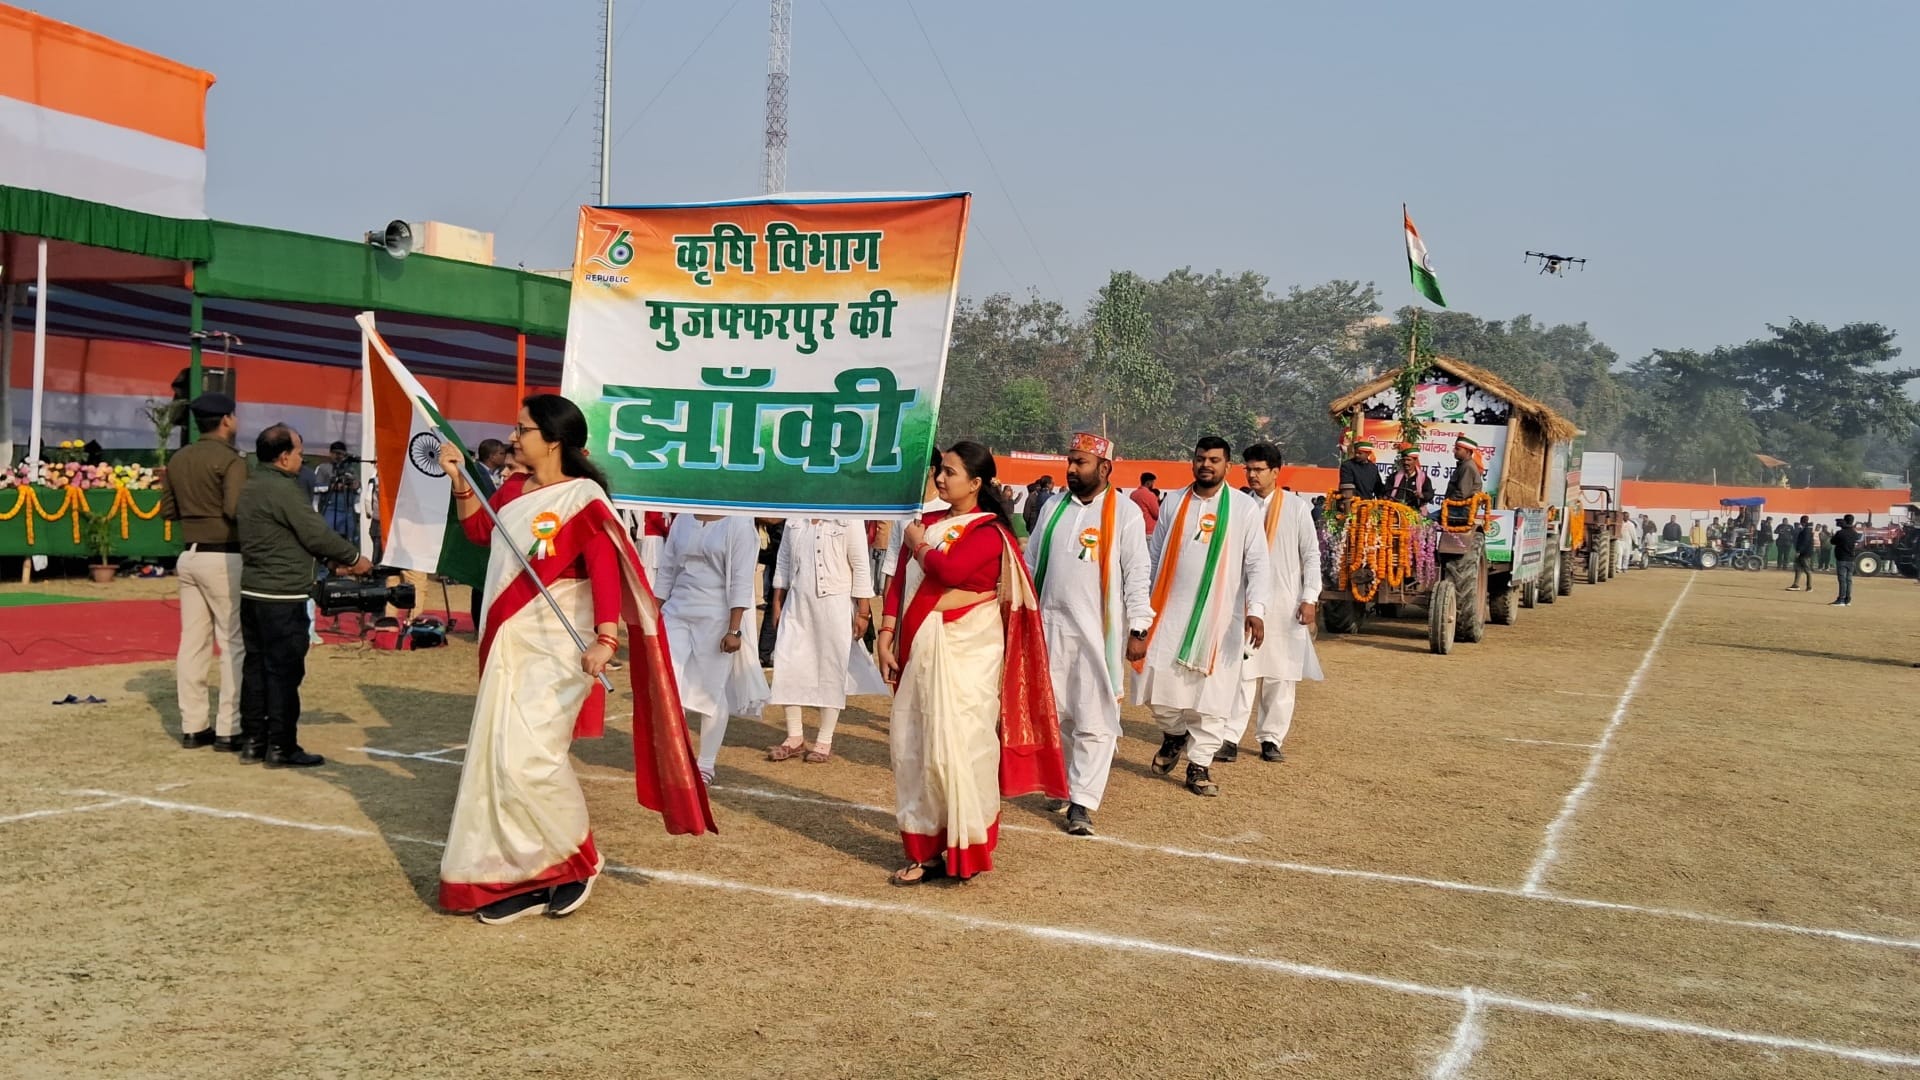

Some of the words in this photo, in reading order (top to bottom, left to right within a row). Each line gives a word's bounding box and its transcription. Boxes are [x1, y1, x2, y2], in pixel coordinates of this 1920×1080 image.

[594, 223, 634, 267] 76
[673, 223, 756, 286] कृषि
[765, 222, 882, 272] विभाग
[585, 274, 629, 283] REPUBLIC
[645, 300, 839, 355] मुजफ्फरपुर
[848, 290, 898, 339] की
[601, 367, 919, 473] झाँकी
